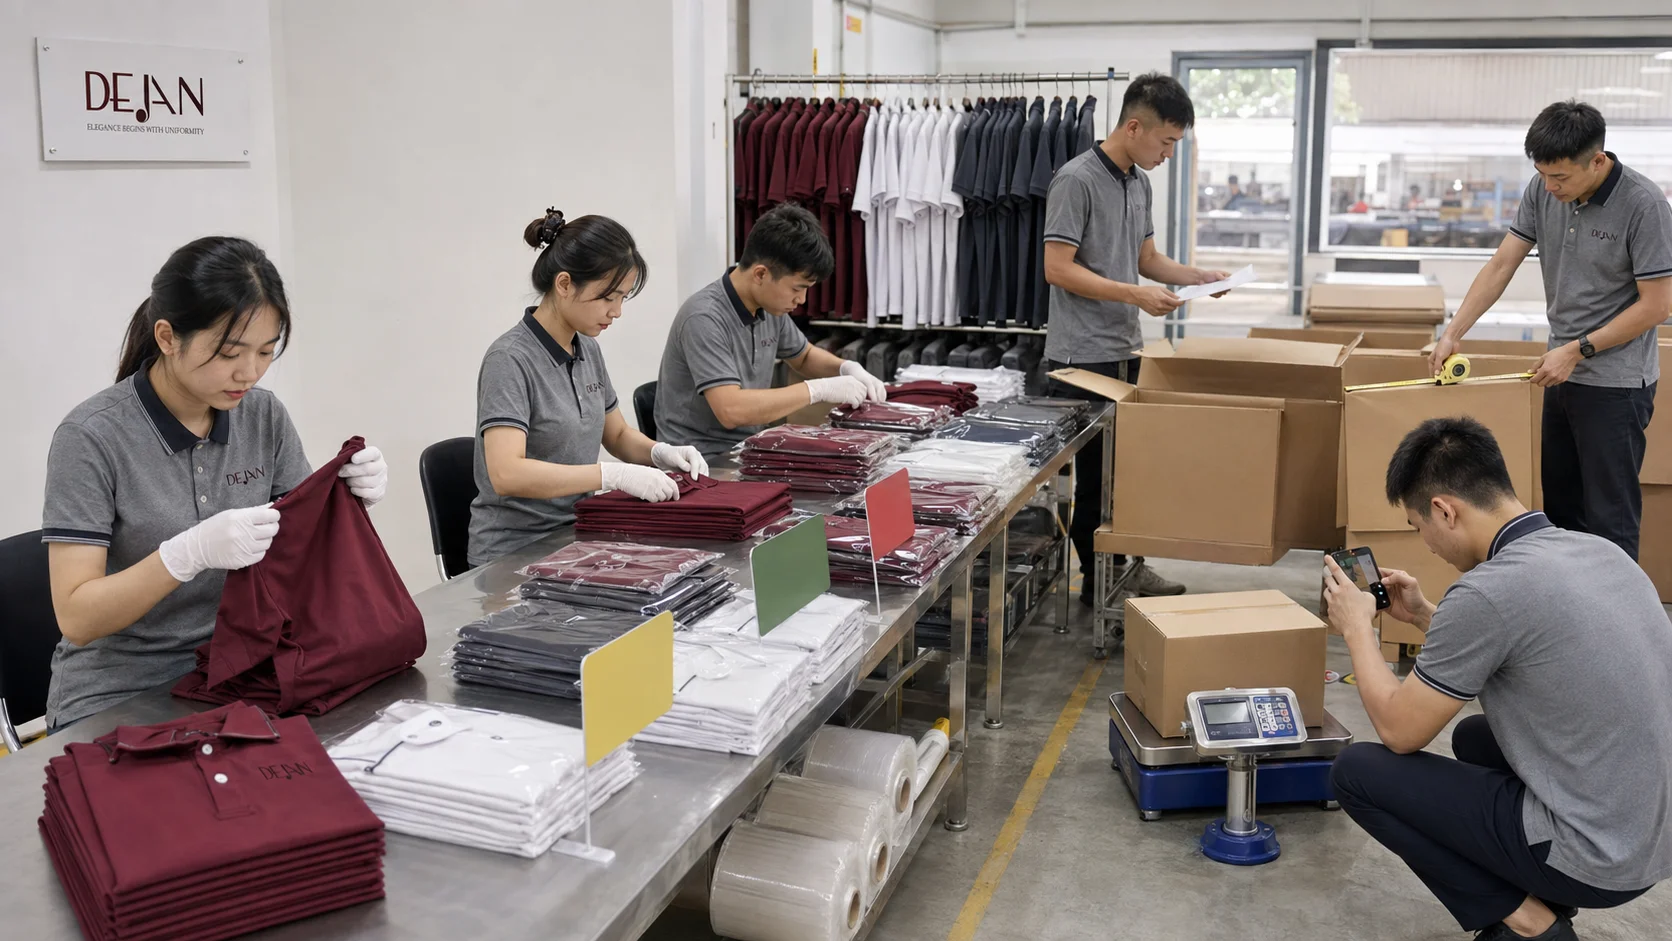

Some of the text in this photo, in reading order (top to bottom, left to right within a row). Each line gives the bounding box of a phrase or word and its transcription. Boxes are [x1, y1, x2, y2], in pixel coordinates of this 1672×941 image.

[85, 70, 204, 123] DEJAN
[87, 123, 204, 135] ELEGANCE BEGINS WITH UNIFORMITY
[226, 465, 265, 486] DEJAN
[258, 761, 313, 780] DEJAN
